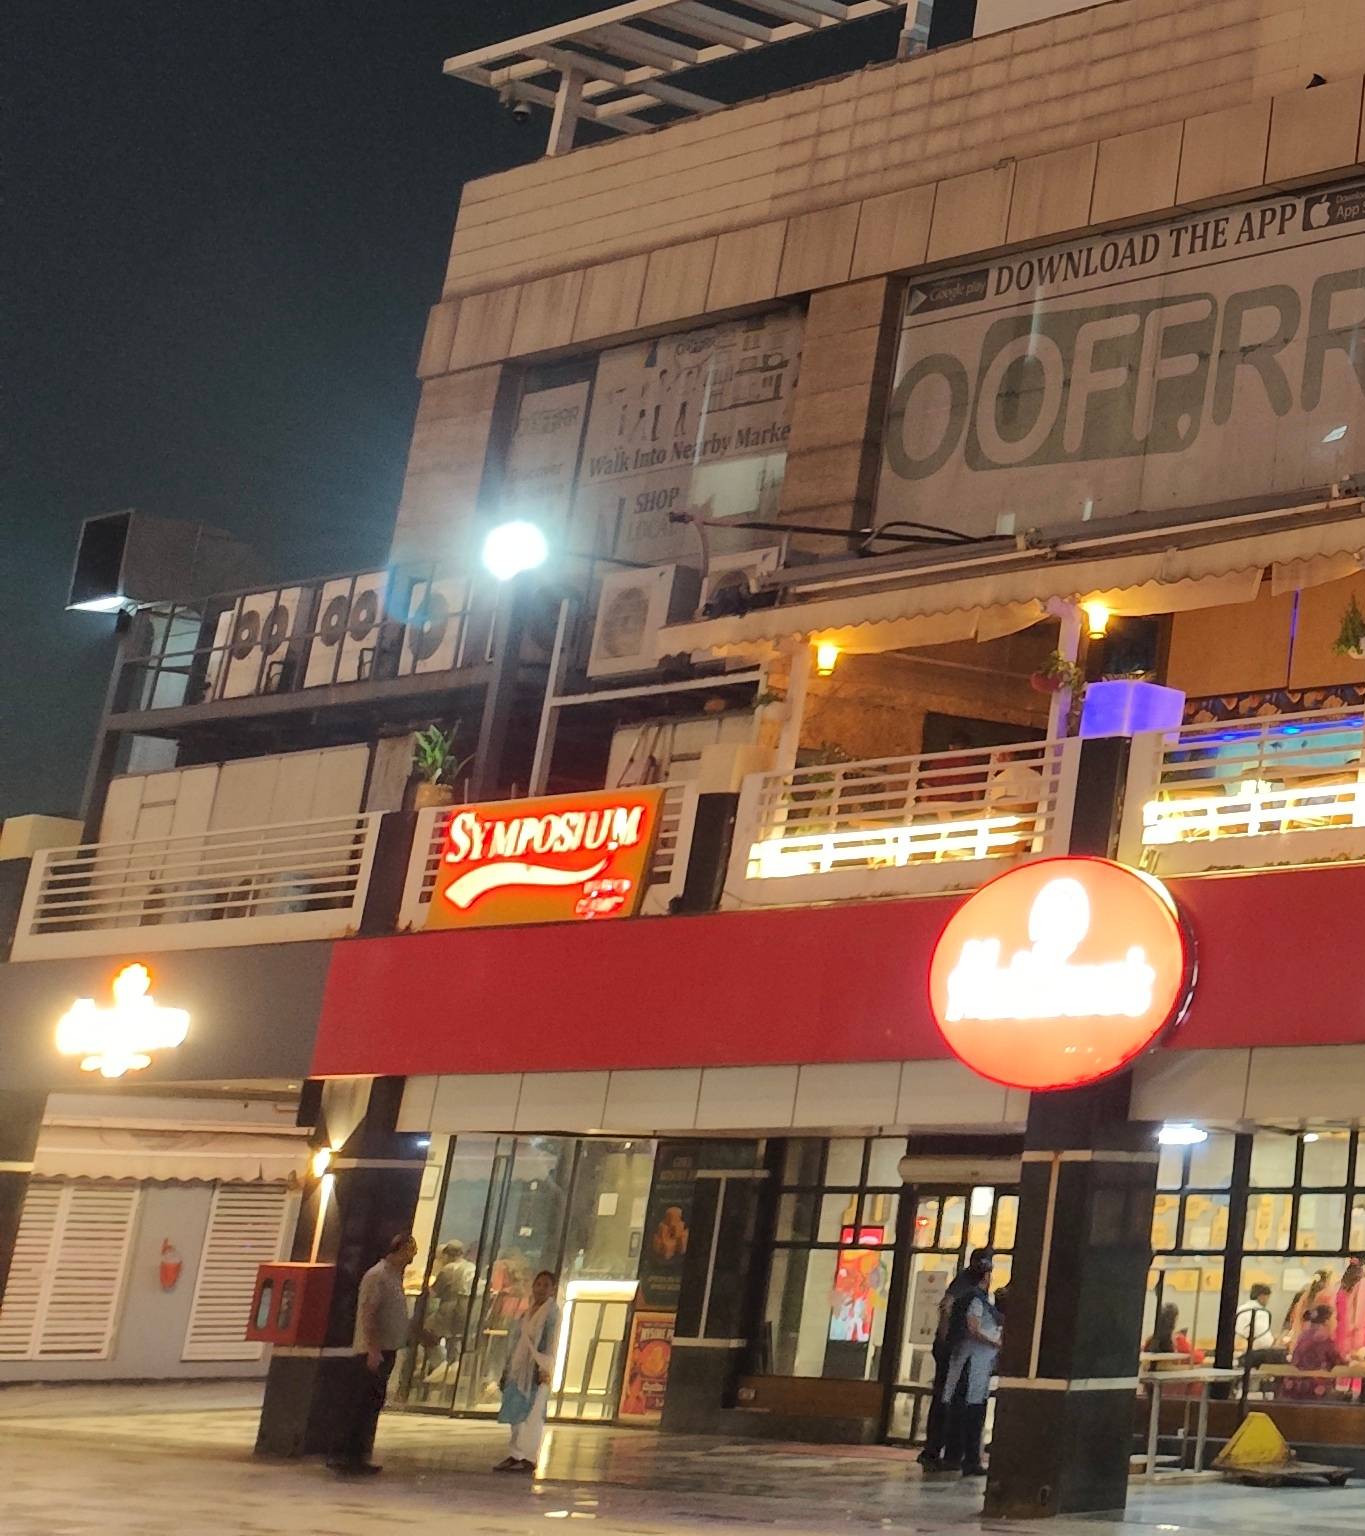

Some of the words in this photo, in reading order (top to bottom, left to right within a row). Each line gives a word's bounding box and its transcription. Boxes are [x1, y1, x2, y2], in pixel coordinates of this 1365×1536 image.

[1335, 203, 1359, 220] App
[993, 233, 1161, 296] DOWNLOAD
[1169, 217, 1229, 258] THE
[1234, 202, 1298, 245] APP
[589, 448, 629, 478] Walk
[633, 446, 667, 470] Into
[671, 432, 732, 461] Nearby
[735, 422, 792, 450] Marke
[633, 487, 680, 514] SHOP
[445, 806, 646, 863] SYMPOSIUM
